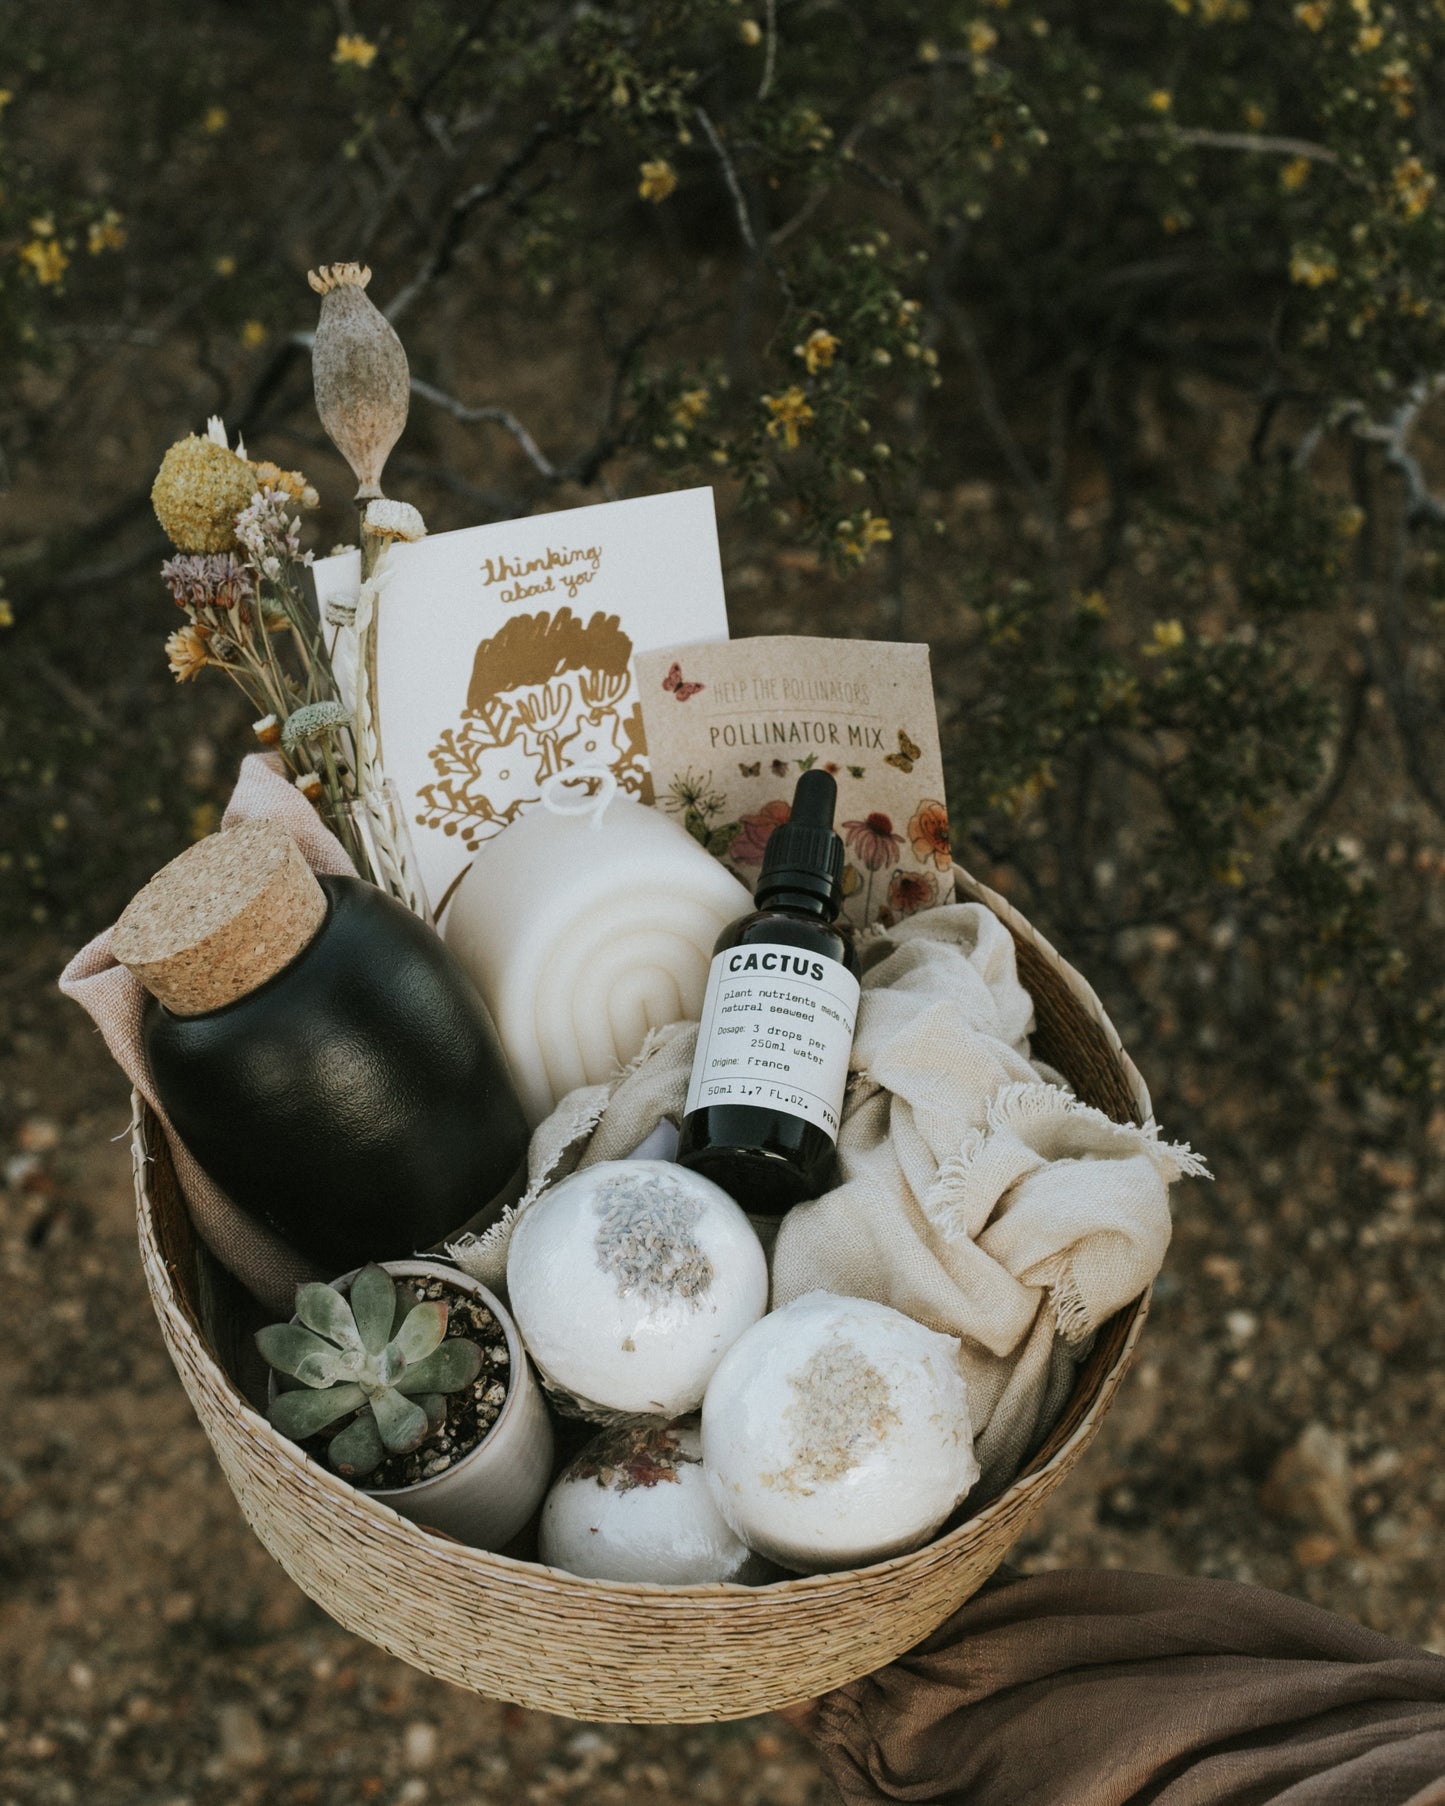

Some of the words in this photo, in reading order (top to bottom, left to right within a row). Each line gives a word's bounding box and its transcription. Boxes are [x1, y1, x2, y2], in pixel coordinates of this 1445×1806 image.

[480, 546, 602, 586] thinking
[500, 576, 555, 603] about
[560, 571, 596, 598] you
[714, 681, 747, 704] HELP
[752, 679, 778, 700] THE
[783, 678, 870, 706] POLLINATORS
[710, 721, 840, 748] POLLINATOR
[848, 725, 885, 750] MIX
[729, 953, 825, 981] CACTUS
[721, 1003, 763, 1014] natural
[770, 1006, 815, 1022] seaweed
[724, 989, 753, 1001] plant
[759, 990, 816, 1008] nutrients
[821, 1005, 840, 1021] made
[718, 1025, 746, 1035] Dosage:
[753, 1025, 760, 1033] 3
[767, 1026, 802, 1041] drops
[808, 1038, 826, 1051] per
[751, 1039, 785, 1052] 250ml
[793, 1048, 825, 1065] water
[712, 1057, 739, 1068] Origine:
[747, 1057, 790, 1072] France
[708, 1085, 733, 1095] 50ml
[740, 1085, 762, 1096] 1,7
